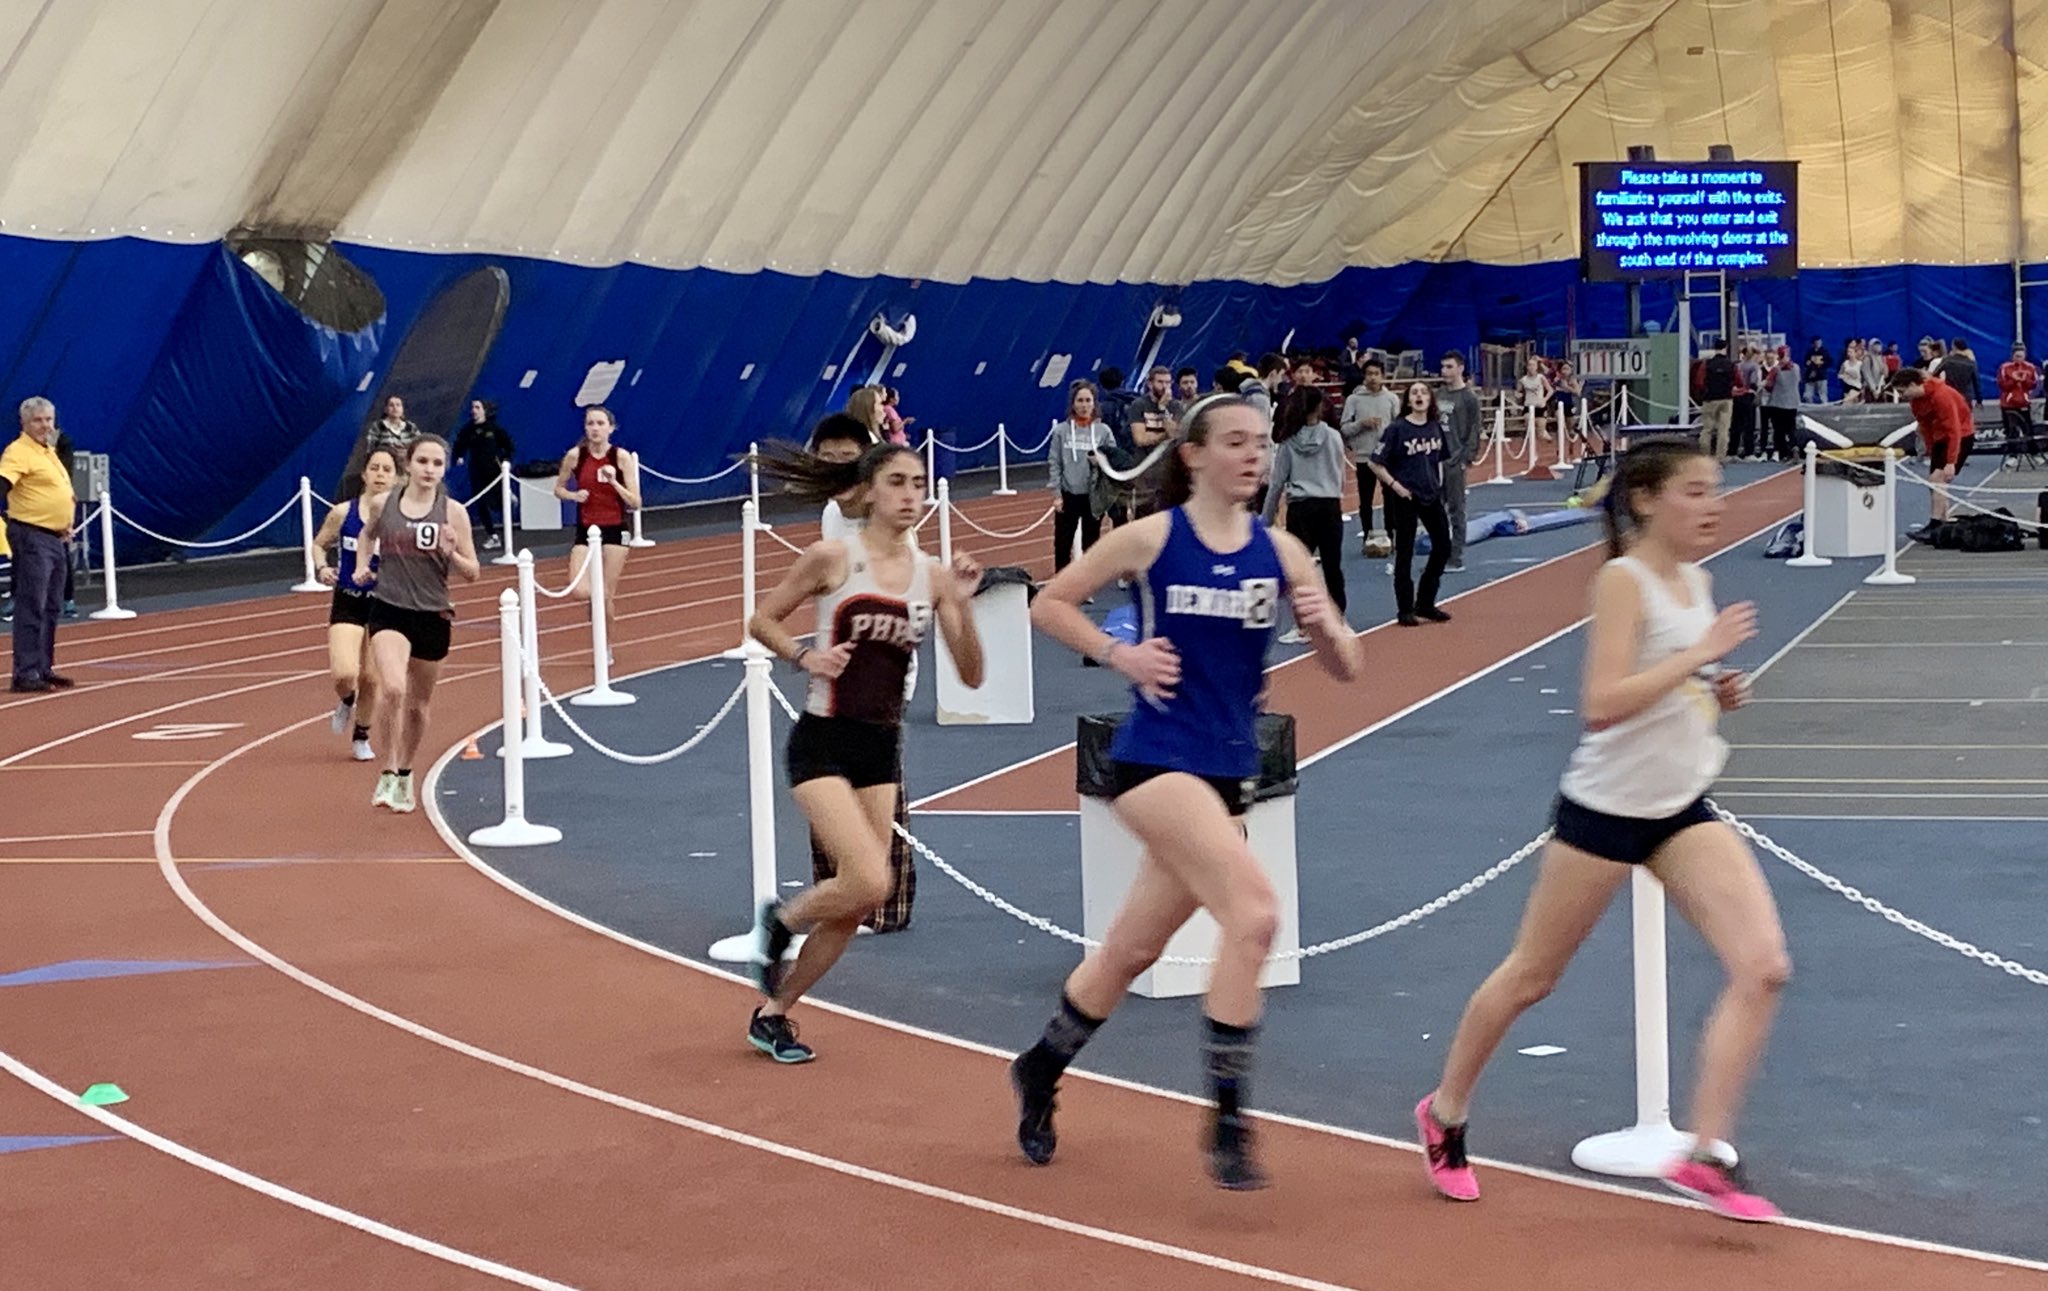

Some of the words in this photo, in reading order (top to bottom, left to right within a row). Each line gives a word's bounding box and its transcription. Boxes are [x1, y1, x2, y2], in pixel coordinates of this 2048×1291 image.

[1621, 169, 1660, 185] Please
[1662, 170, 1688, 185] take
[1690, 172, 1699, 185] a
[1701, 171, 1747, 185] moment
[1748, 170, 1763, 185] to
[1595, 189, 1655, 206] familiarize
[1658, 188, 1705, 208] yourself
[1708, 189, 1731, 205] with
[1732, 189, 1752, 205] the
[1754, 188, 1786, 205] exits.
[1602, 210, 1623, 226] We
[1626, 210, 1648, 226] ask
[1650, 210, 1673, 226] that
[1675, 212, 1699, 229] you
[1701, 211, 1731, 226] enter
[1733, 209, 1755, 225] and
[1757, 209, 1779, 225] exit
[1596, 231, 1641, 249] through
[1643, 231, 1663, 246] the
[1665, 230, 1719, 249] revolving
[1722, 230, 1753, 245] doors
[1755, 231, 1768, 245] at
[1768, 230, 1789, 245] the
[1620, 251, 1653, 268] south
[1654, 251, 1677, 266] end
[1679, 251, 1692, 266] of
[1694, 250, 1714, 266] the
[1716, 250, 1768, 269] complex.
[421, 525, 435, 548] 9
